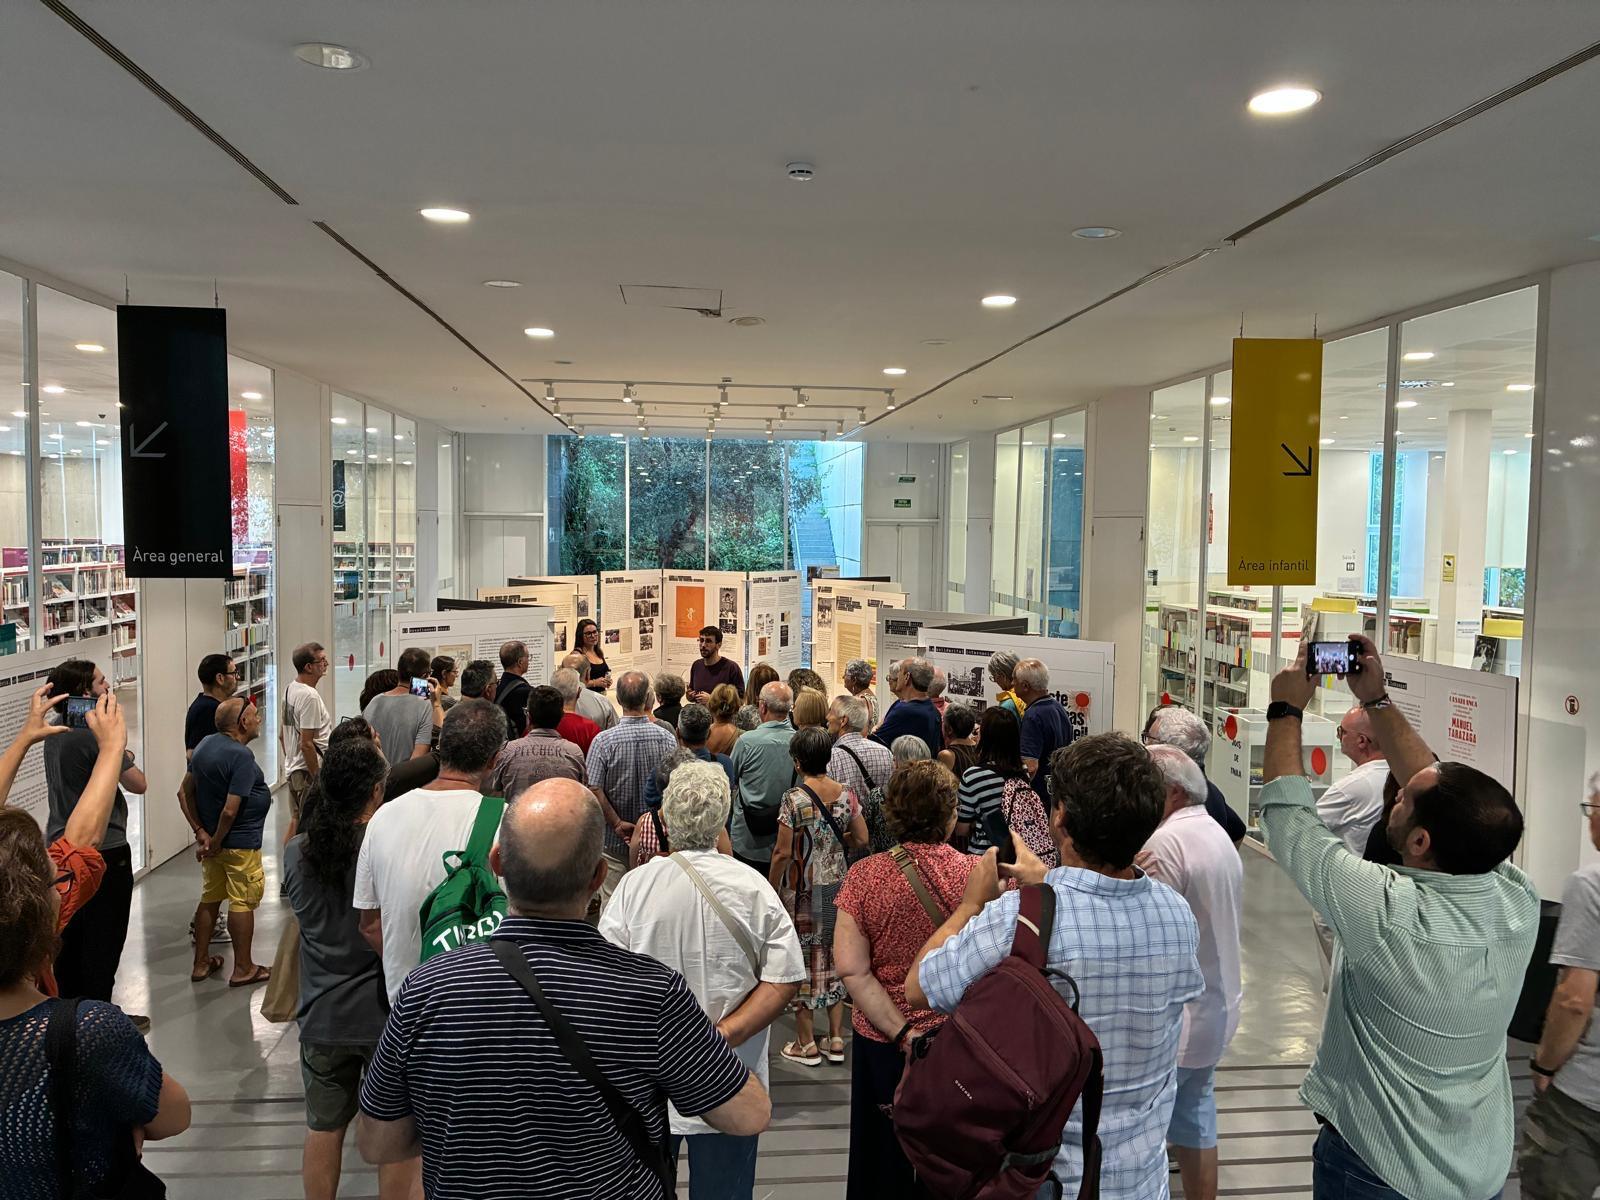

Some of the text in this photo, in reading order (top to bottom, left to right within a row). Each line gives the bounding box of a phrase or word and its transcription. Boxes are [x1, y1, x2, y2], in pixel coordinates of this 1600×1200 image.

[132, 546, 224, 565] Àrea general
[1269, 560, 1310, 571] infantil
[1452, 717, 1473, 731] MANUEL
[1448, 728, 1477, 743] TARAZAGA
